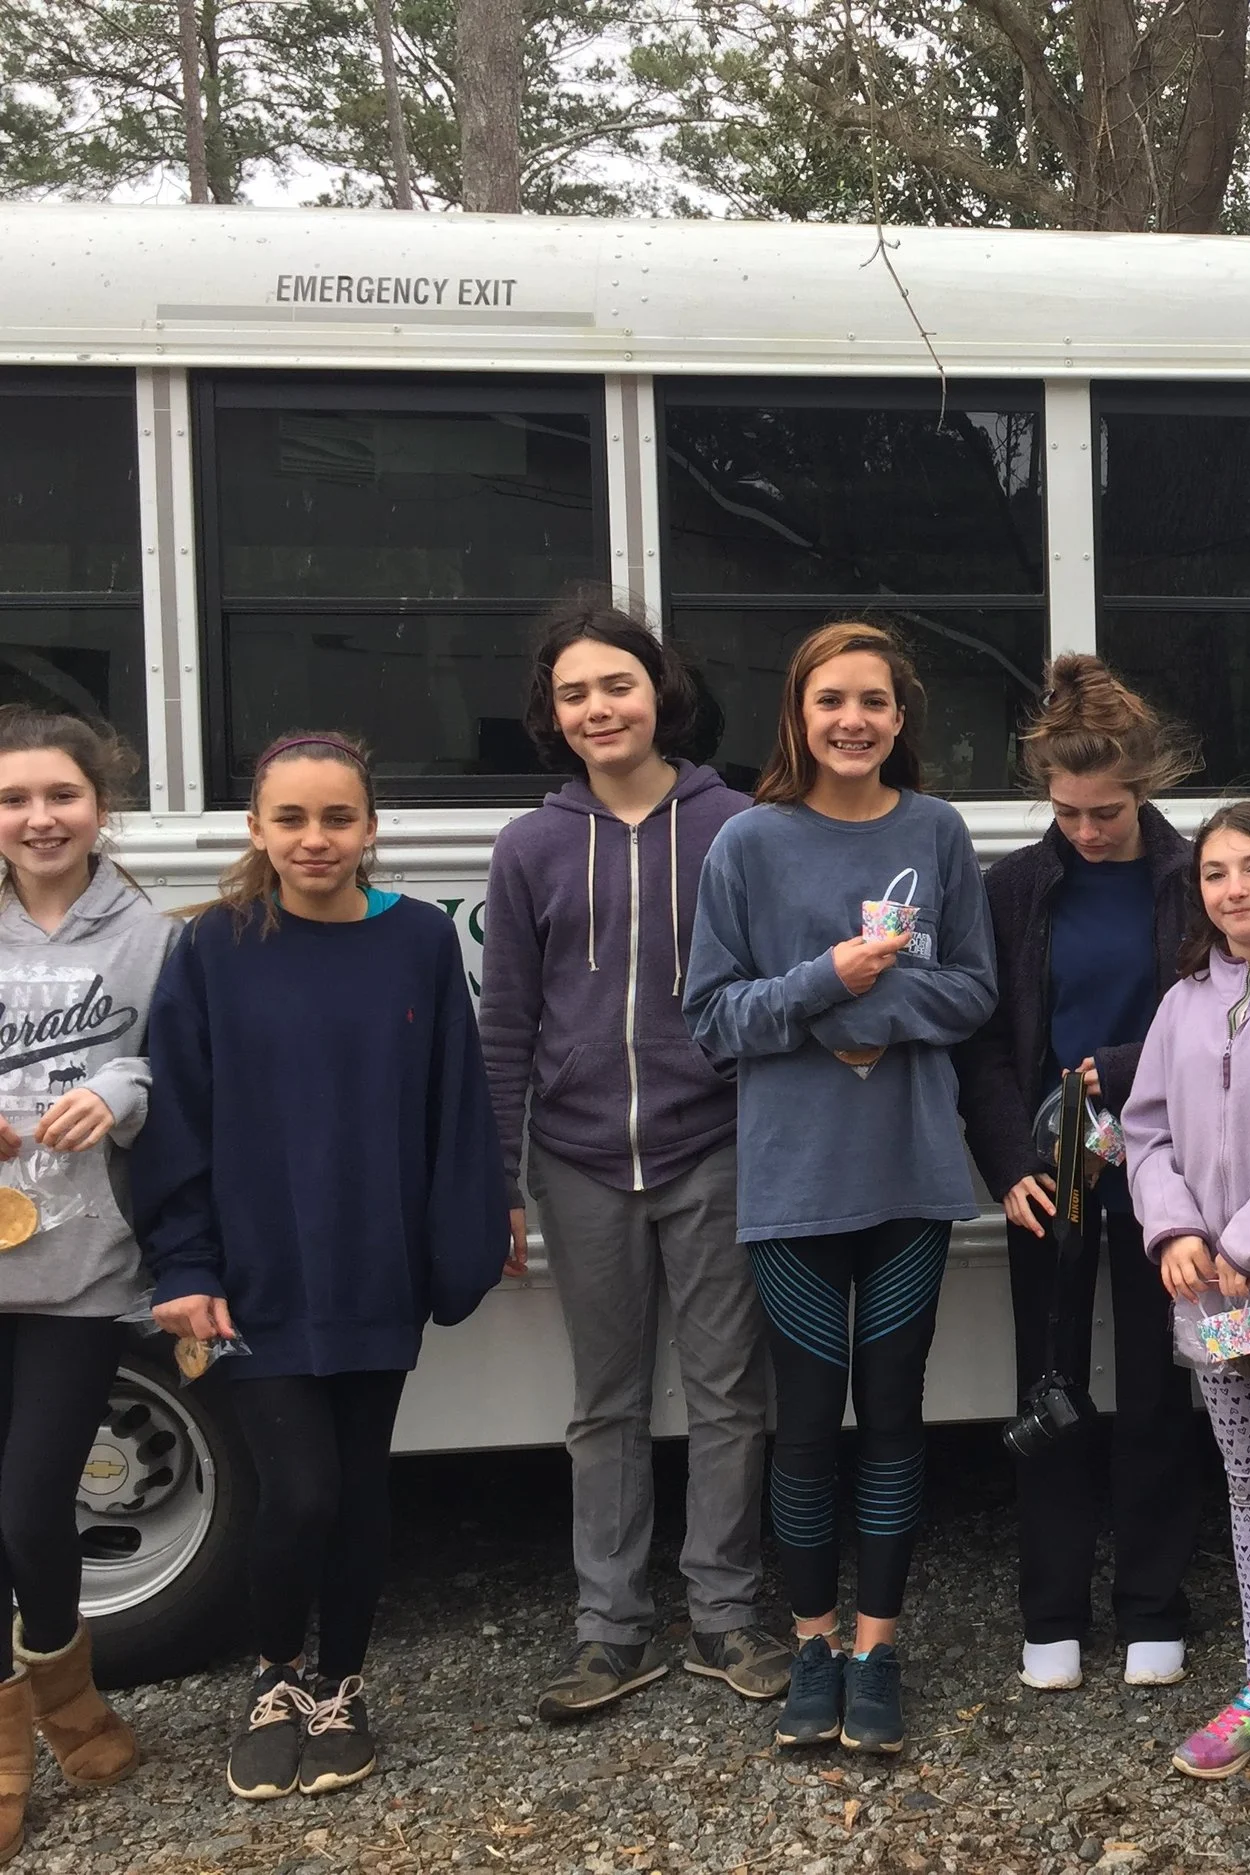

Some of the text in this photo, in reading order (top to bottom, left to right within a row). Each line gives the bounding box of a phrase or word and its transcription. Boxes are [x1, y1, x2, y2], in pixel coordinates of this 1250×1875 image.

[276, 274, 517, 306] EMERGENCY EXIT
[0, 974, 113, 1050] orado
